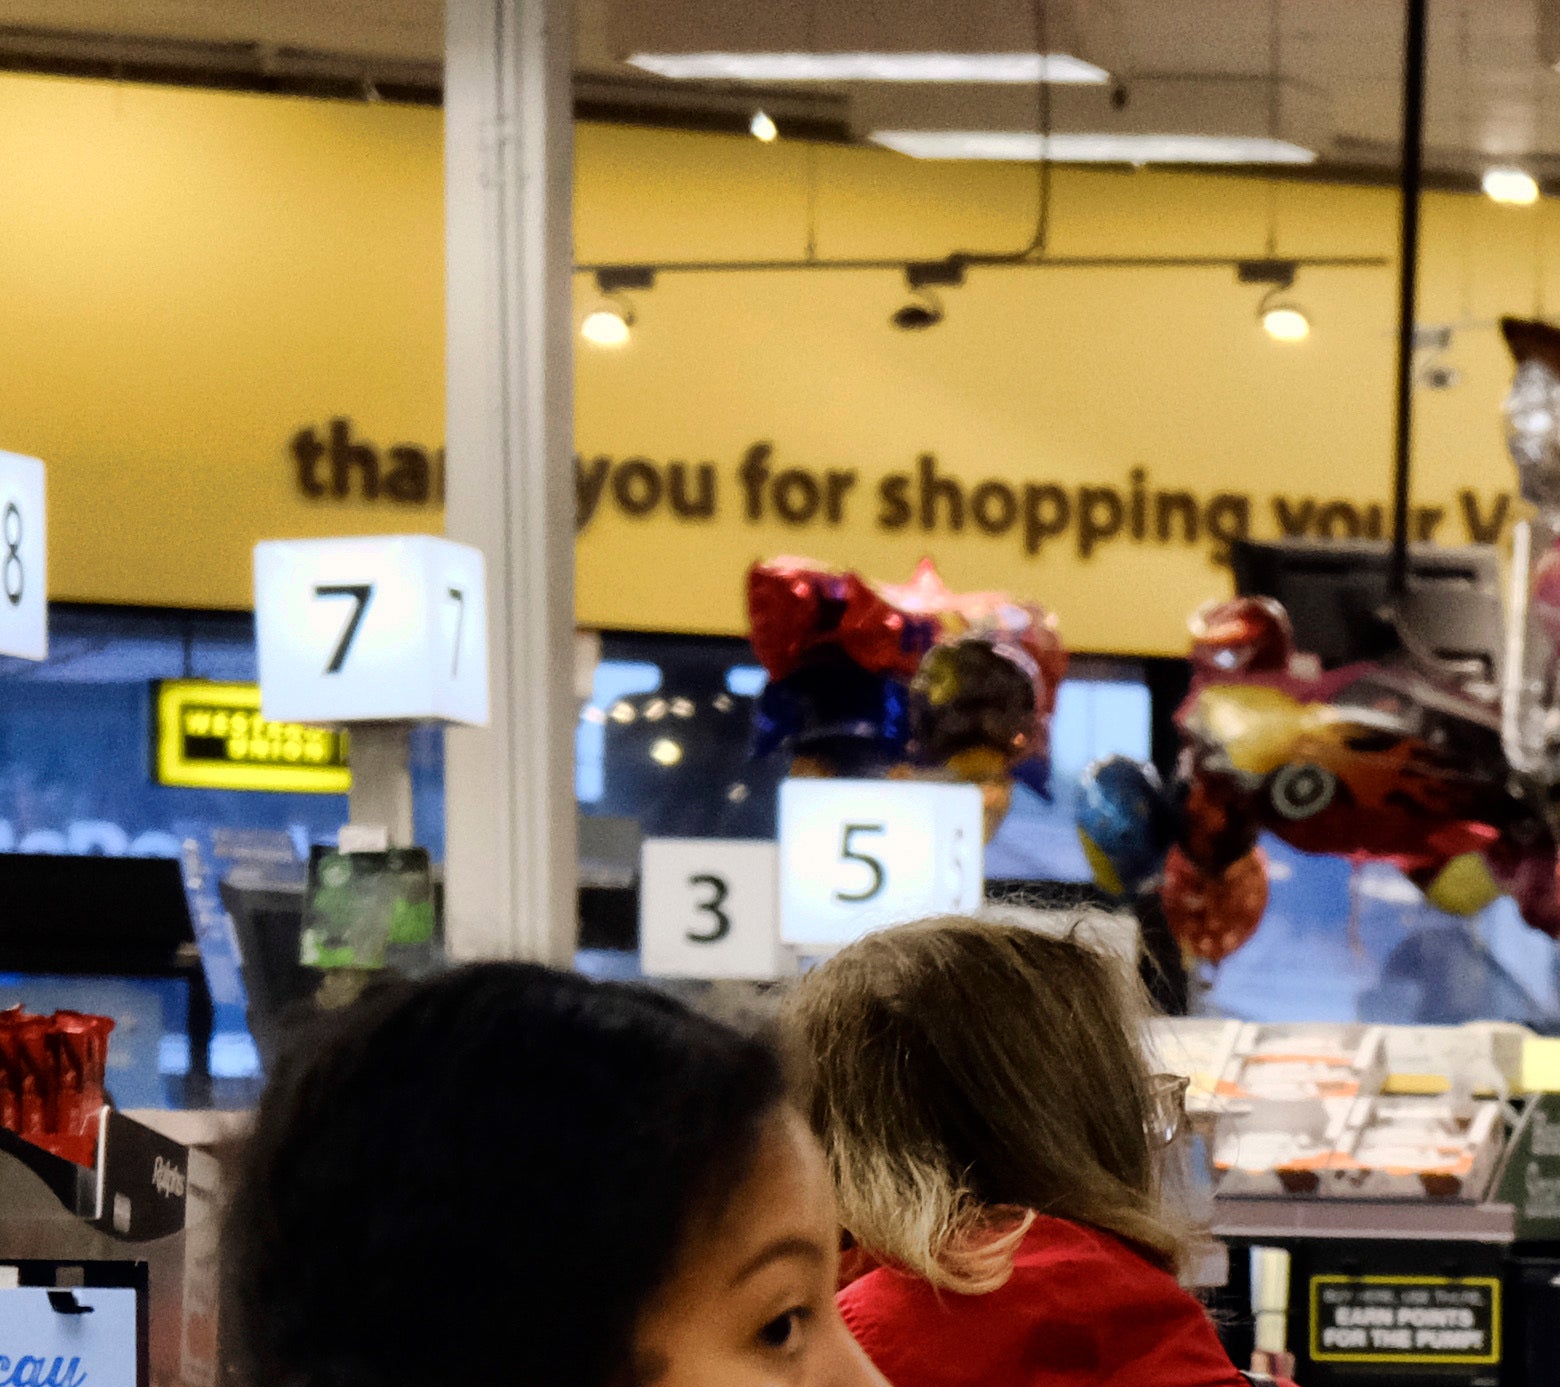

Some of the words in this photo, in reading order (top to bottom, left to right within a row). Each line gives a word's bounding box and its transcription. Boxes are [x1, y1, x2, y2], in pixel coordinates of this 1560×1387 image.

[290, 416, 446, 504] tha
[574, 454, 717, 536] you
[737, 440, 861, 527] for
[876, 453, 1250, 561] shopping
[4, 501, 25, 607] 8
[313, 583, 376, 675] 7
[834, 821, 884, 902] 5
[684, 872, 732, 944] 3
[1322, 1327, 1367, 1348] FOR
[1370, 1327, 1413, 1349] THE
[1396, 1307, 1474, 1329] POINTS
